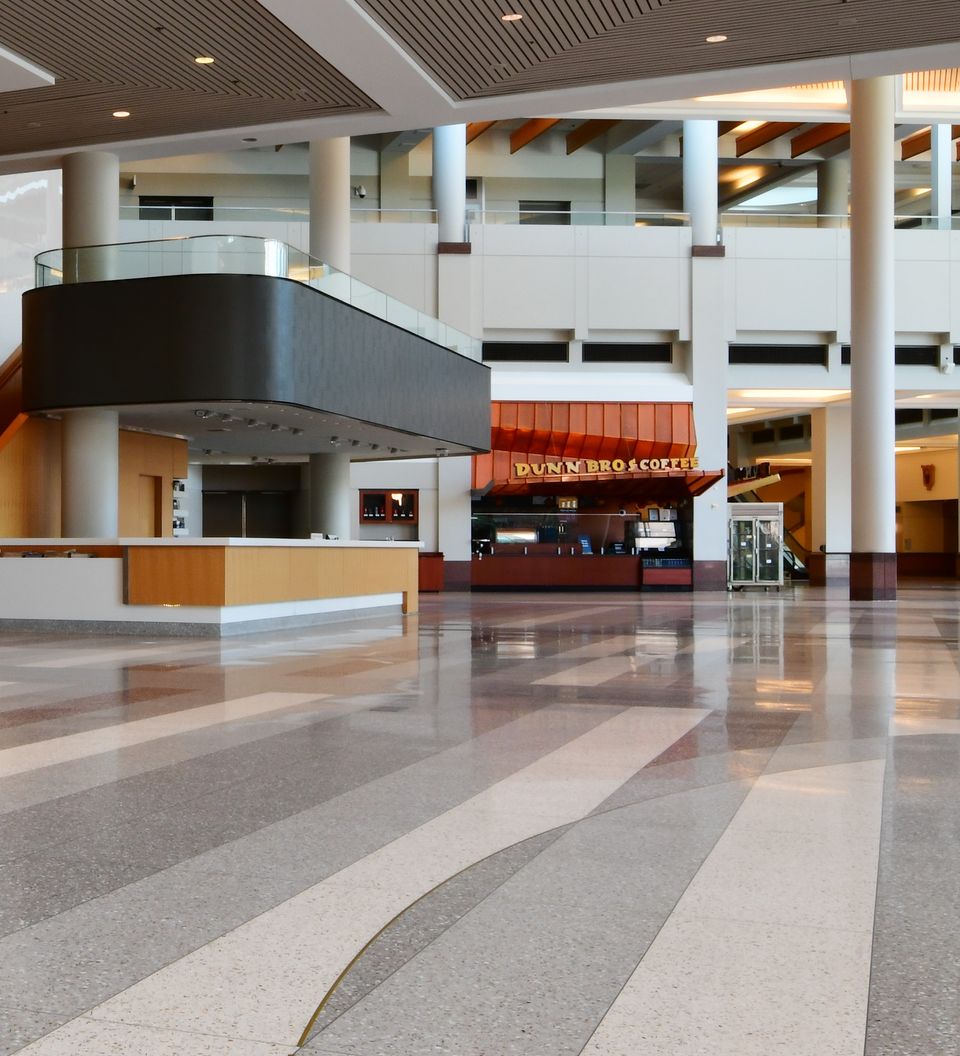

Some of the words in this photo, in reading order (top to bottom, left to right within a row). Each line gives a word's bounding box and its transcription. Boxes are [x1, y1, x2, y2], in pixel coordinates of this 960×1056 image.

[515, 461, 582, 477] DUNN
[584, 459, 638, 473] BROS
[639, 457, 699, 470] COFFEE
